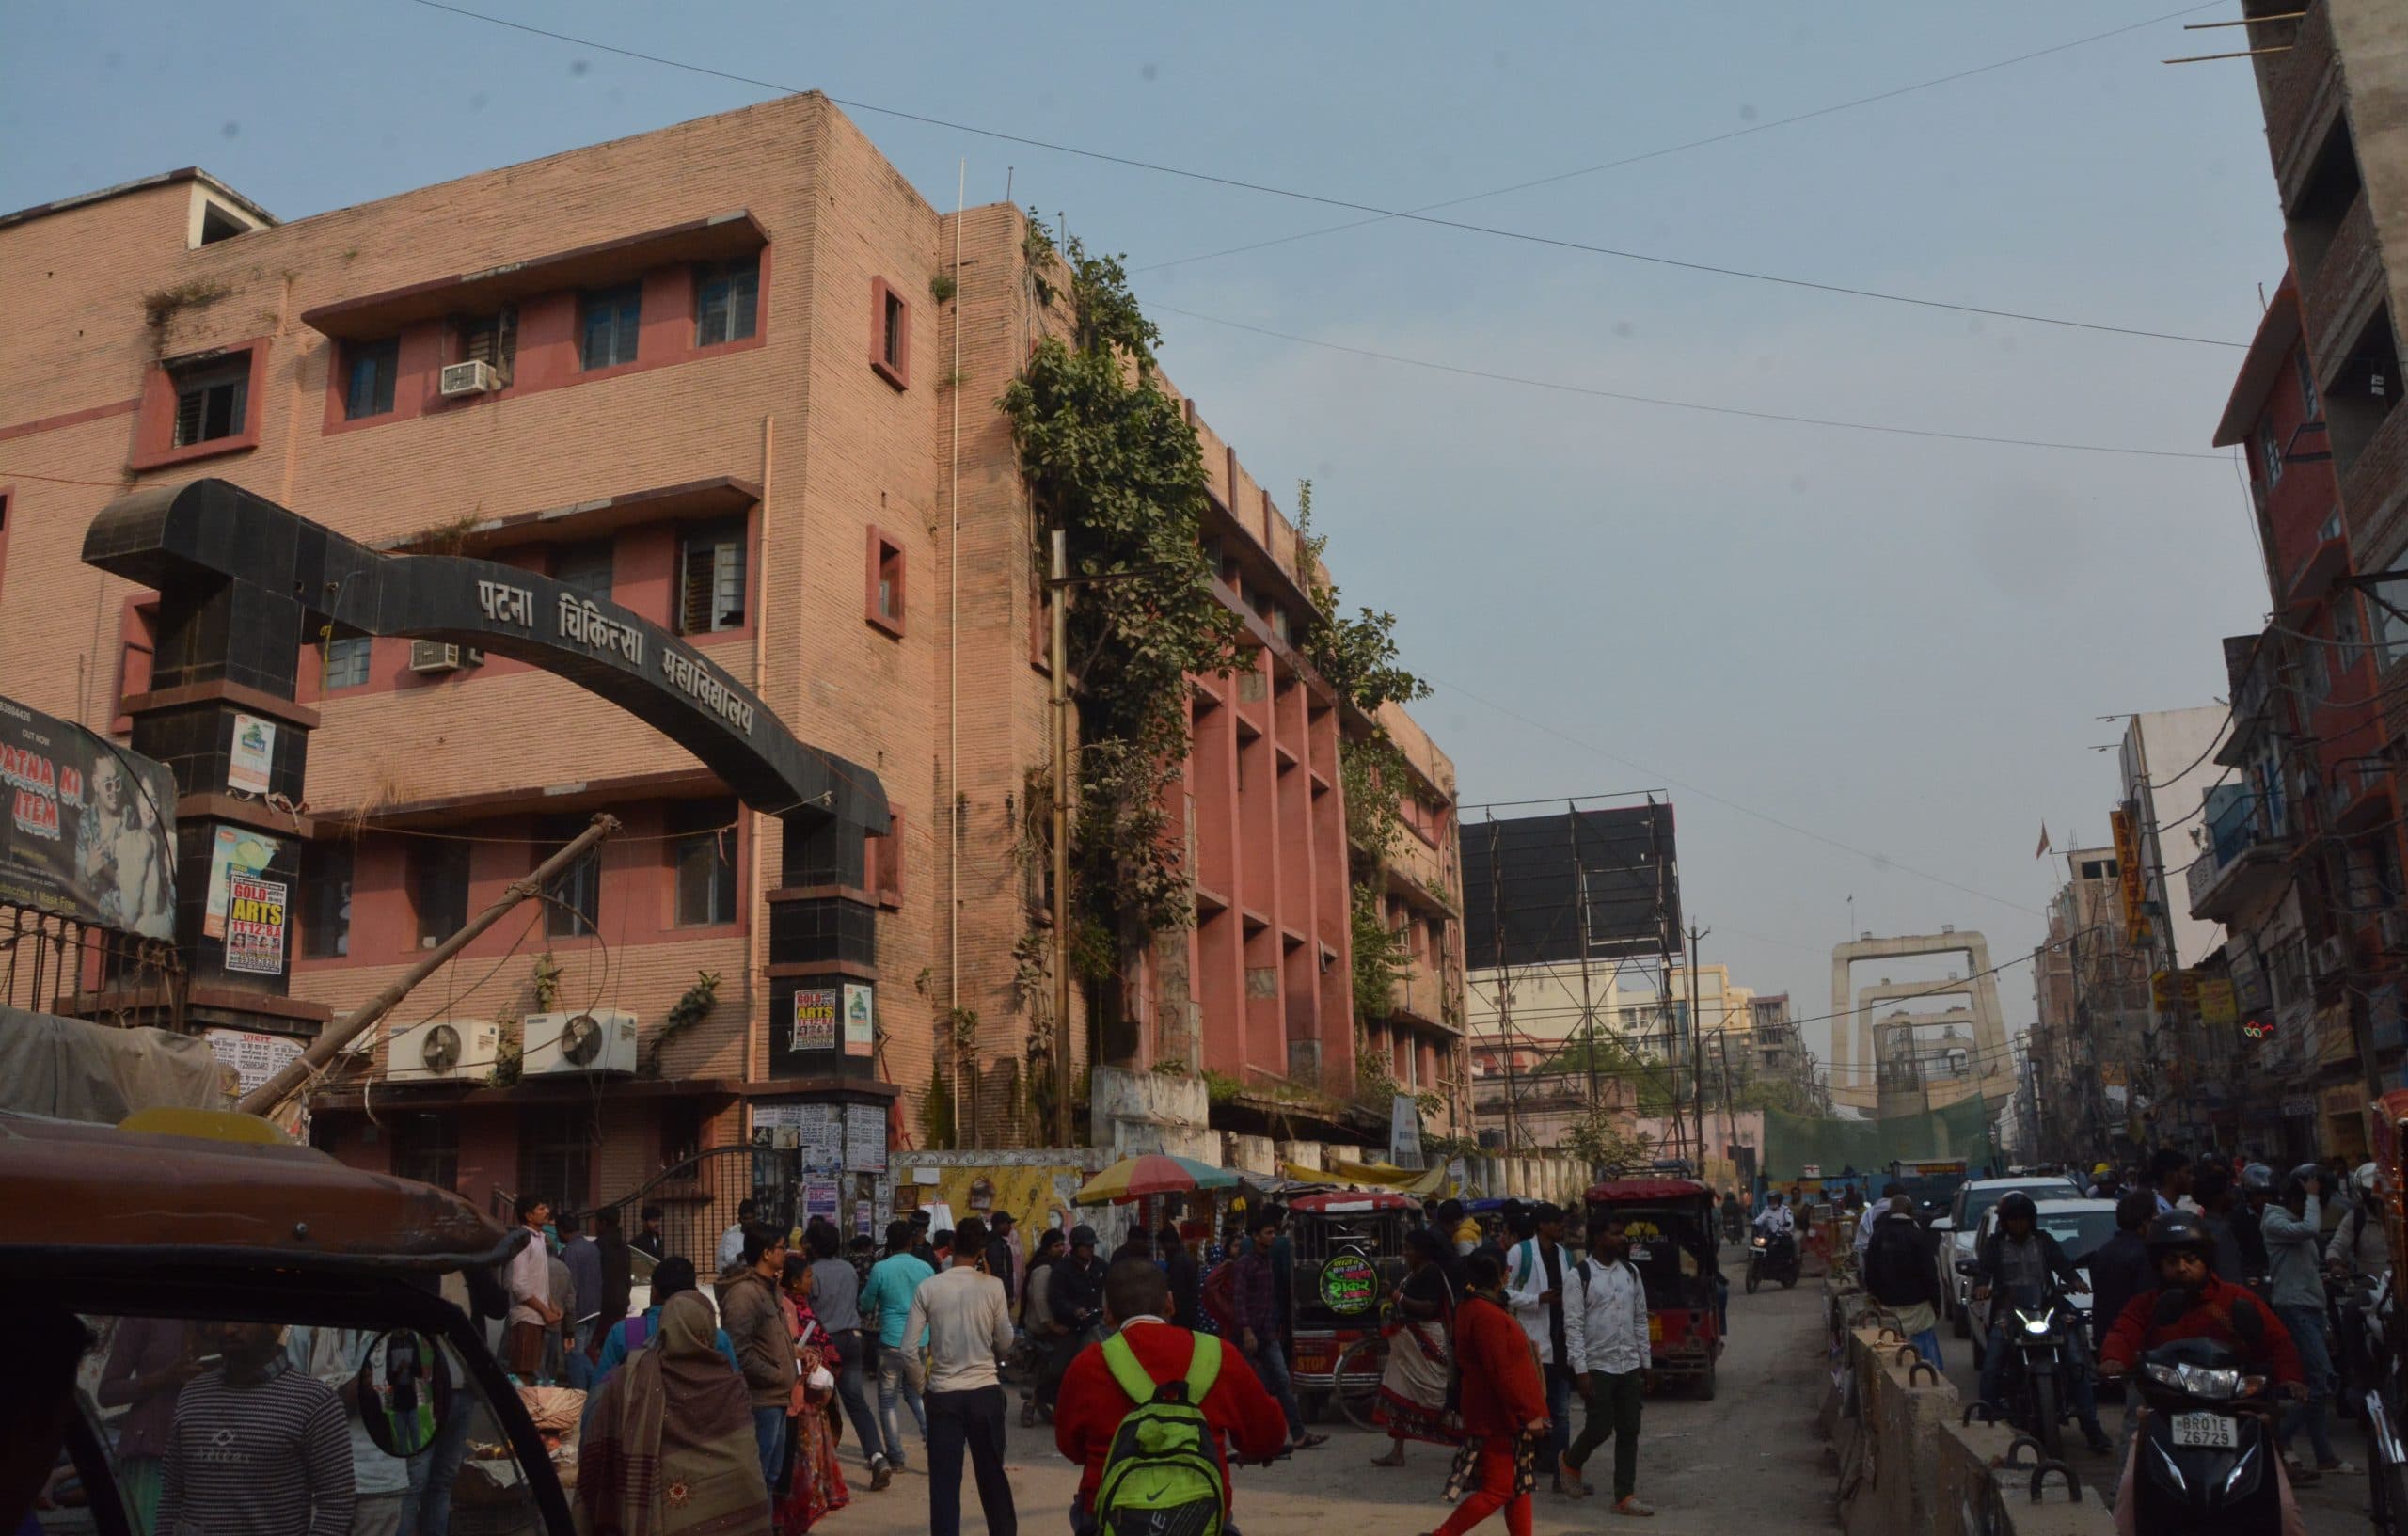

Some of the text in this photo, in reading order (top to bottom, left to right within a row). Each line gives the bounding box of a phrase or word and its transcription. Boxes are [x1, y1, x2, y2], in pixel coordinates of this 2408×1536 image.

[478, 579, 754, 736] पटना चिकित्सा महाविद्यालय
[22, 729, 35, 740] OUT
[59, 765, 84, 805] KI
[14, 788, 60, 838] ITEM
[234, 883, 266, 901] GOLD
[232, 898, 282, 926] ARTS
[798, 993, 821, 1003] GOLD
[798, 1006, 833, 1019] ARTS
[243, 1034, 271, 1042] VISIT
[1296, 1354, 1327, 1370] STOP
[2183, 1417, 2228, 1432] BR01E
[2183, 1431, 2229, 1446] Z6729
